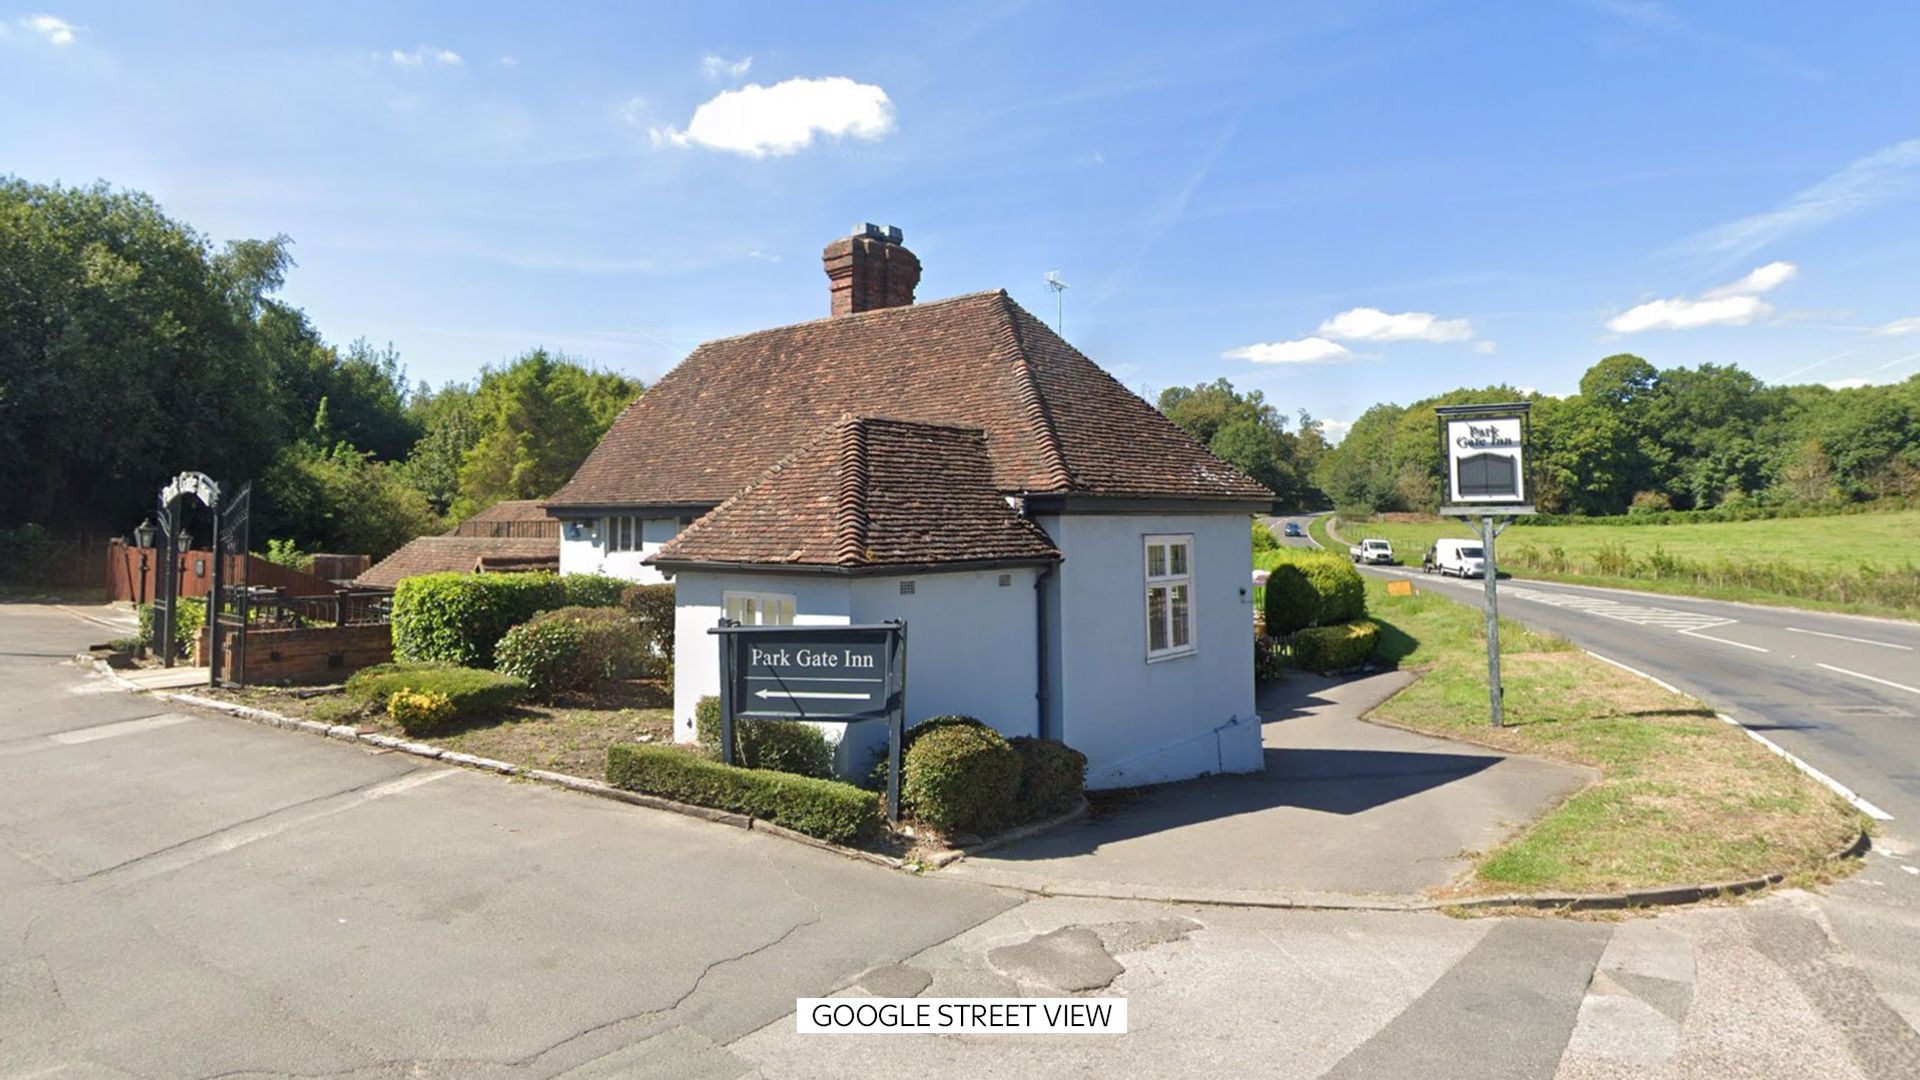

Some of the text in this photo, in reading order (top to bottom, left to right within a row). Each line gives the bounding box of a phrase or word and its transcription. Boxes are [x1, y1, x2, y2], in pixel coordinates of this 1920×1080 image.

[1468, 425, 1500, 438] Park
[1456, 436, 1513, 449] Gate Inn
[751, 648, 874, 668] Park Gate Inn
